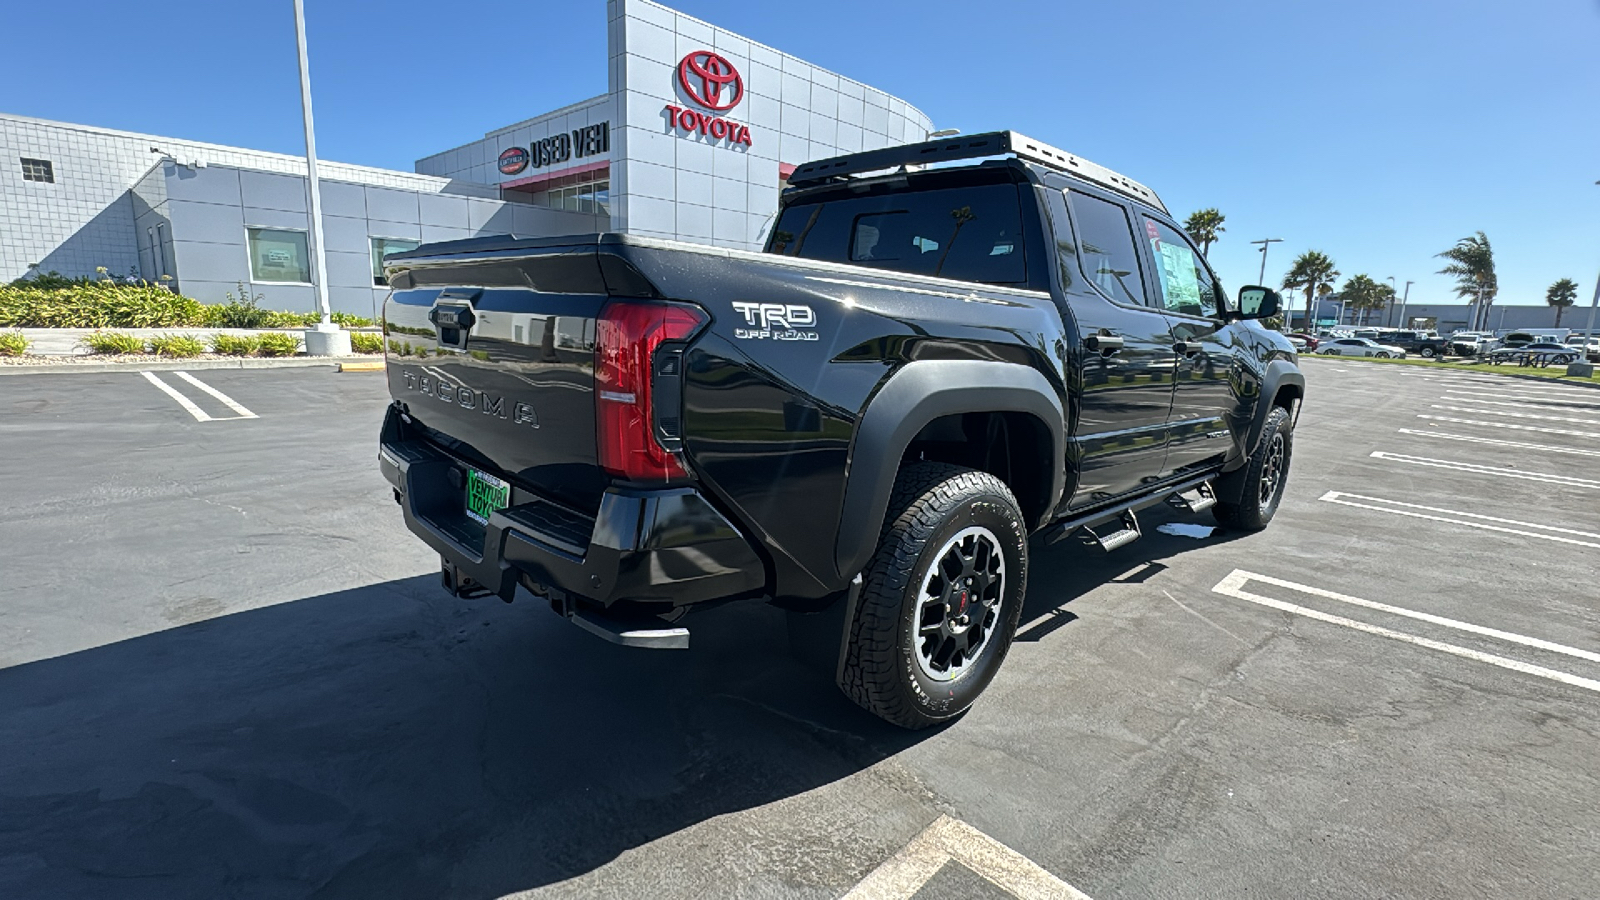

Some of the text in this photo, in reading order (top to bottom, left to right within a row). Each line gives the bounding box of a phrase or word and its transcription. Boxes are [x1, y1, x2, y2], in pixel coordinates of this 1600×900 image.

[666, 105, 752, 146] TOYOTA
[530, 133, 571, 168] USED
[732, 301, 816, 330] TRD
[734, 328, 819, 341] OFF ROAD
[403, 370, 540, 429] TACOMA
[471, 477, 508, 508] VENTURA
[472, 493, 496, 518] TOYO
